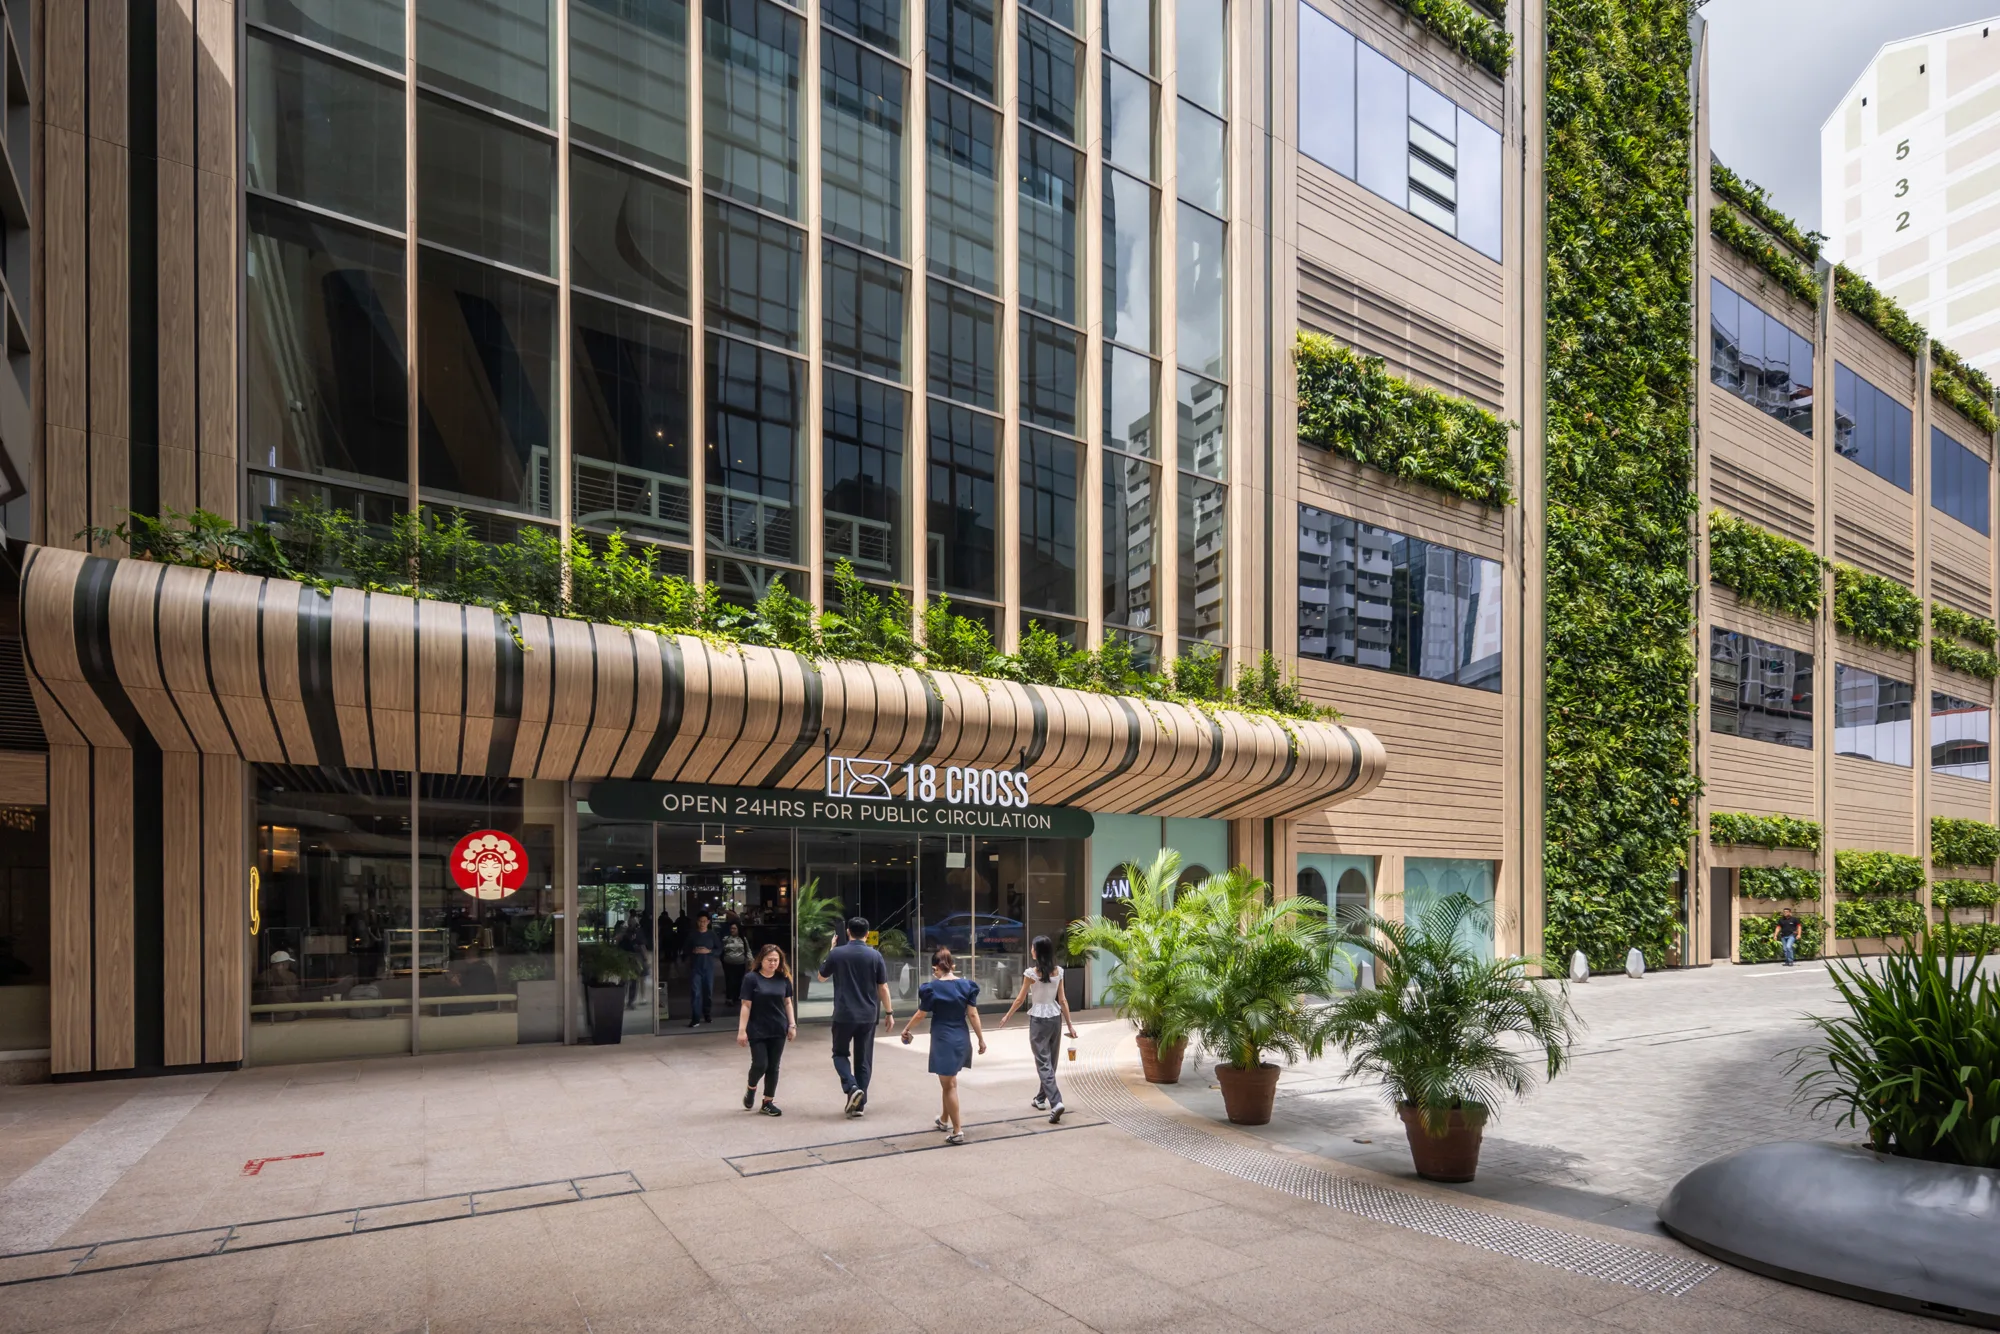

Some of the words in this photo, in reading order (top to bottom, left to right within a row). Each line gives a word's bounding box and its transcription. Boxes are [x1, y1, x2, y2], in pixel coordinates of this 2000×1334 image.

[901, 763, 936, 802] 18
[946, 766, 1029, 808] CROSS
[662, 793, 727, 814] OPEN
[735, 797, 806, 819] 24HRS
[813, 802, 853, 820] FOR
[860, 805, 929, 824] PUBLIC
[935, 809, 1051, 829] CIRCULATION
